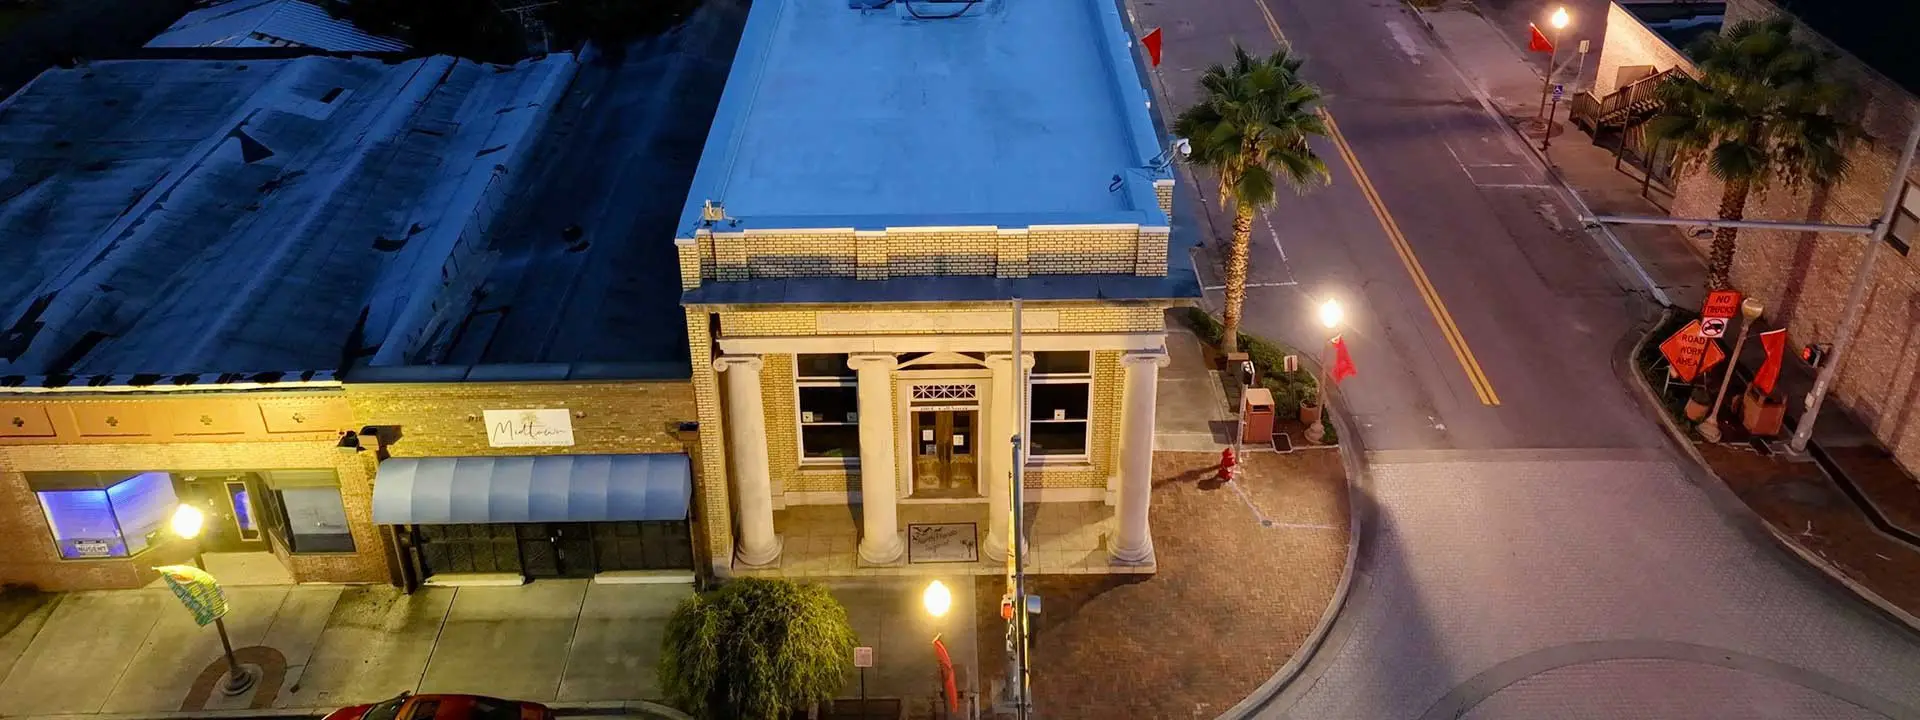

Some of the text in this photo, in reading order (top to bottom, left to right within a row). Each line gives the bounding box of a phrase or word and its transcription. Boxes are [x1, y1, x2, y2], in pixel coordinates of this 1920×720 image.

[1715, 295, 1730, 304] NO
[1681, 334, 1705, 345] ROAD
[1675, 356, 1700, 367] AHEA
